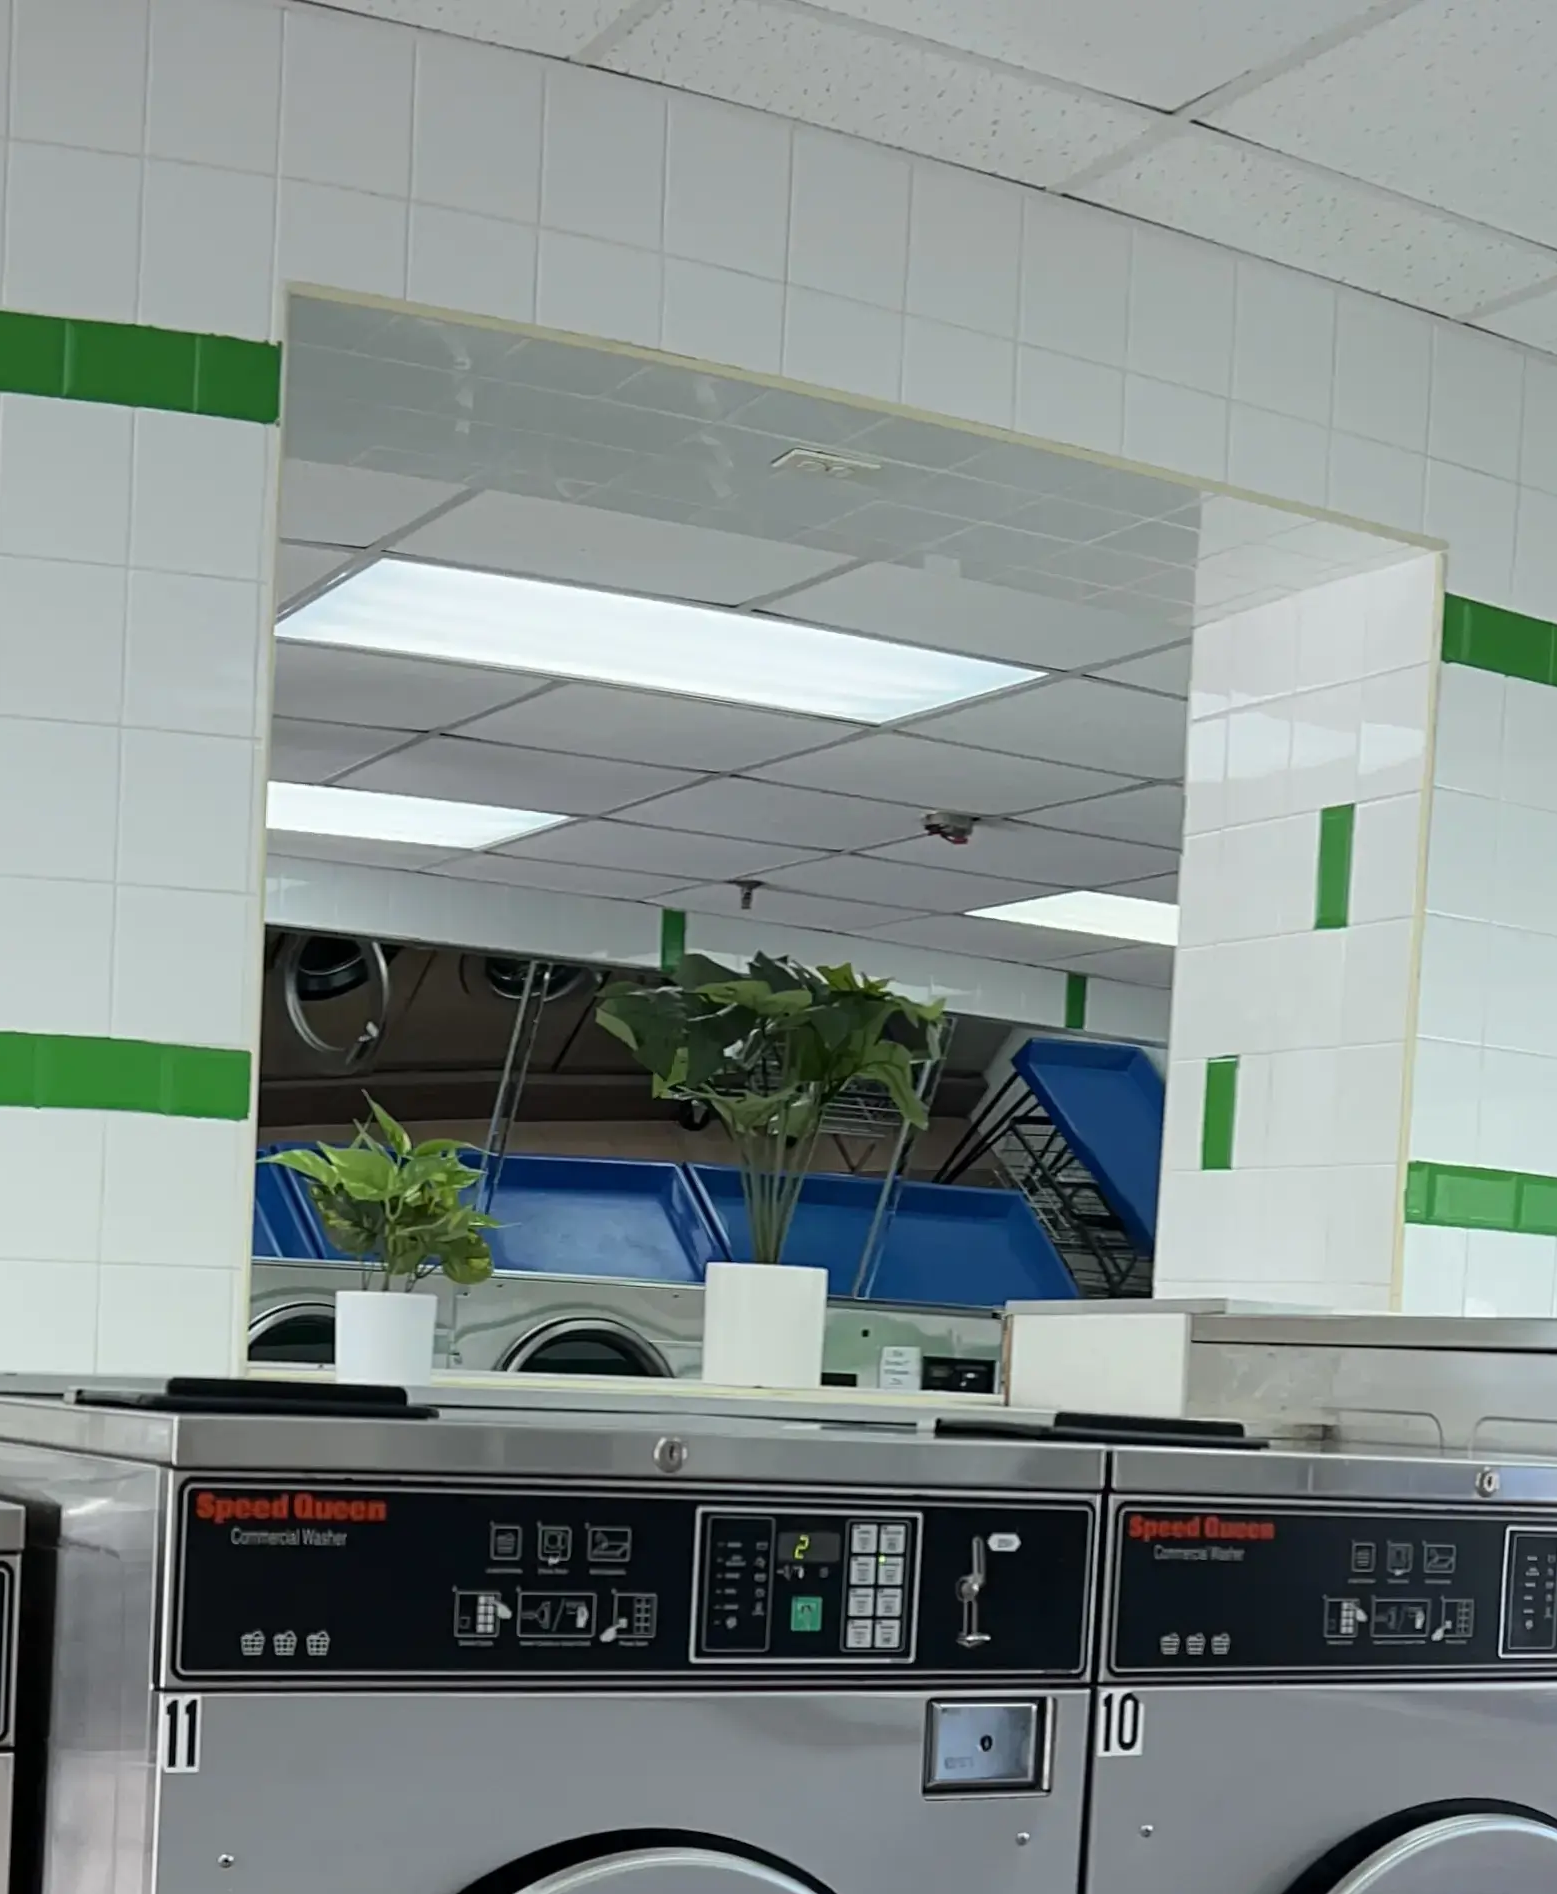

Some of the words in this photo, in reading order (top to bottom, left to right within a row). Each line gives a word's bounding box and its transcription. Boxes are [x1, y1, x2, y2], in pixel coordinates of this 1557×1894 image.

[196, 1492, 287, 1523] Speed
[292, 1493, 387, 1521] Queen
[230, 1527, 299, 1547] Commercial
[302, 1528, 347, 1548] Washer
[1129, 1515, 1199, 1542] Speed
[1204, 1515, 1275, 1540] Queen
[795, 1534, 810, 1559] 2
[166, 1700, 197, 1768] 11
[1102, 1692, 1140, 1752] 10
